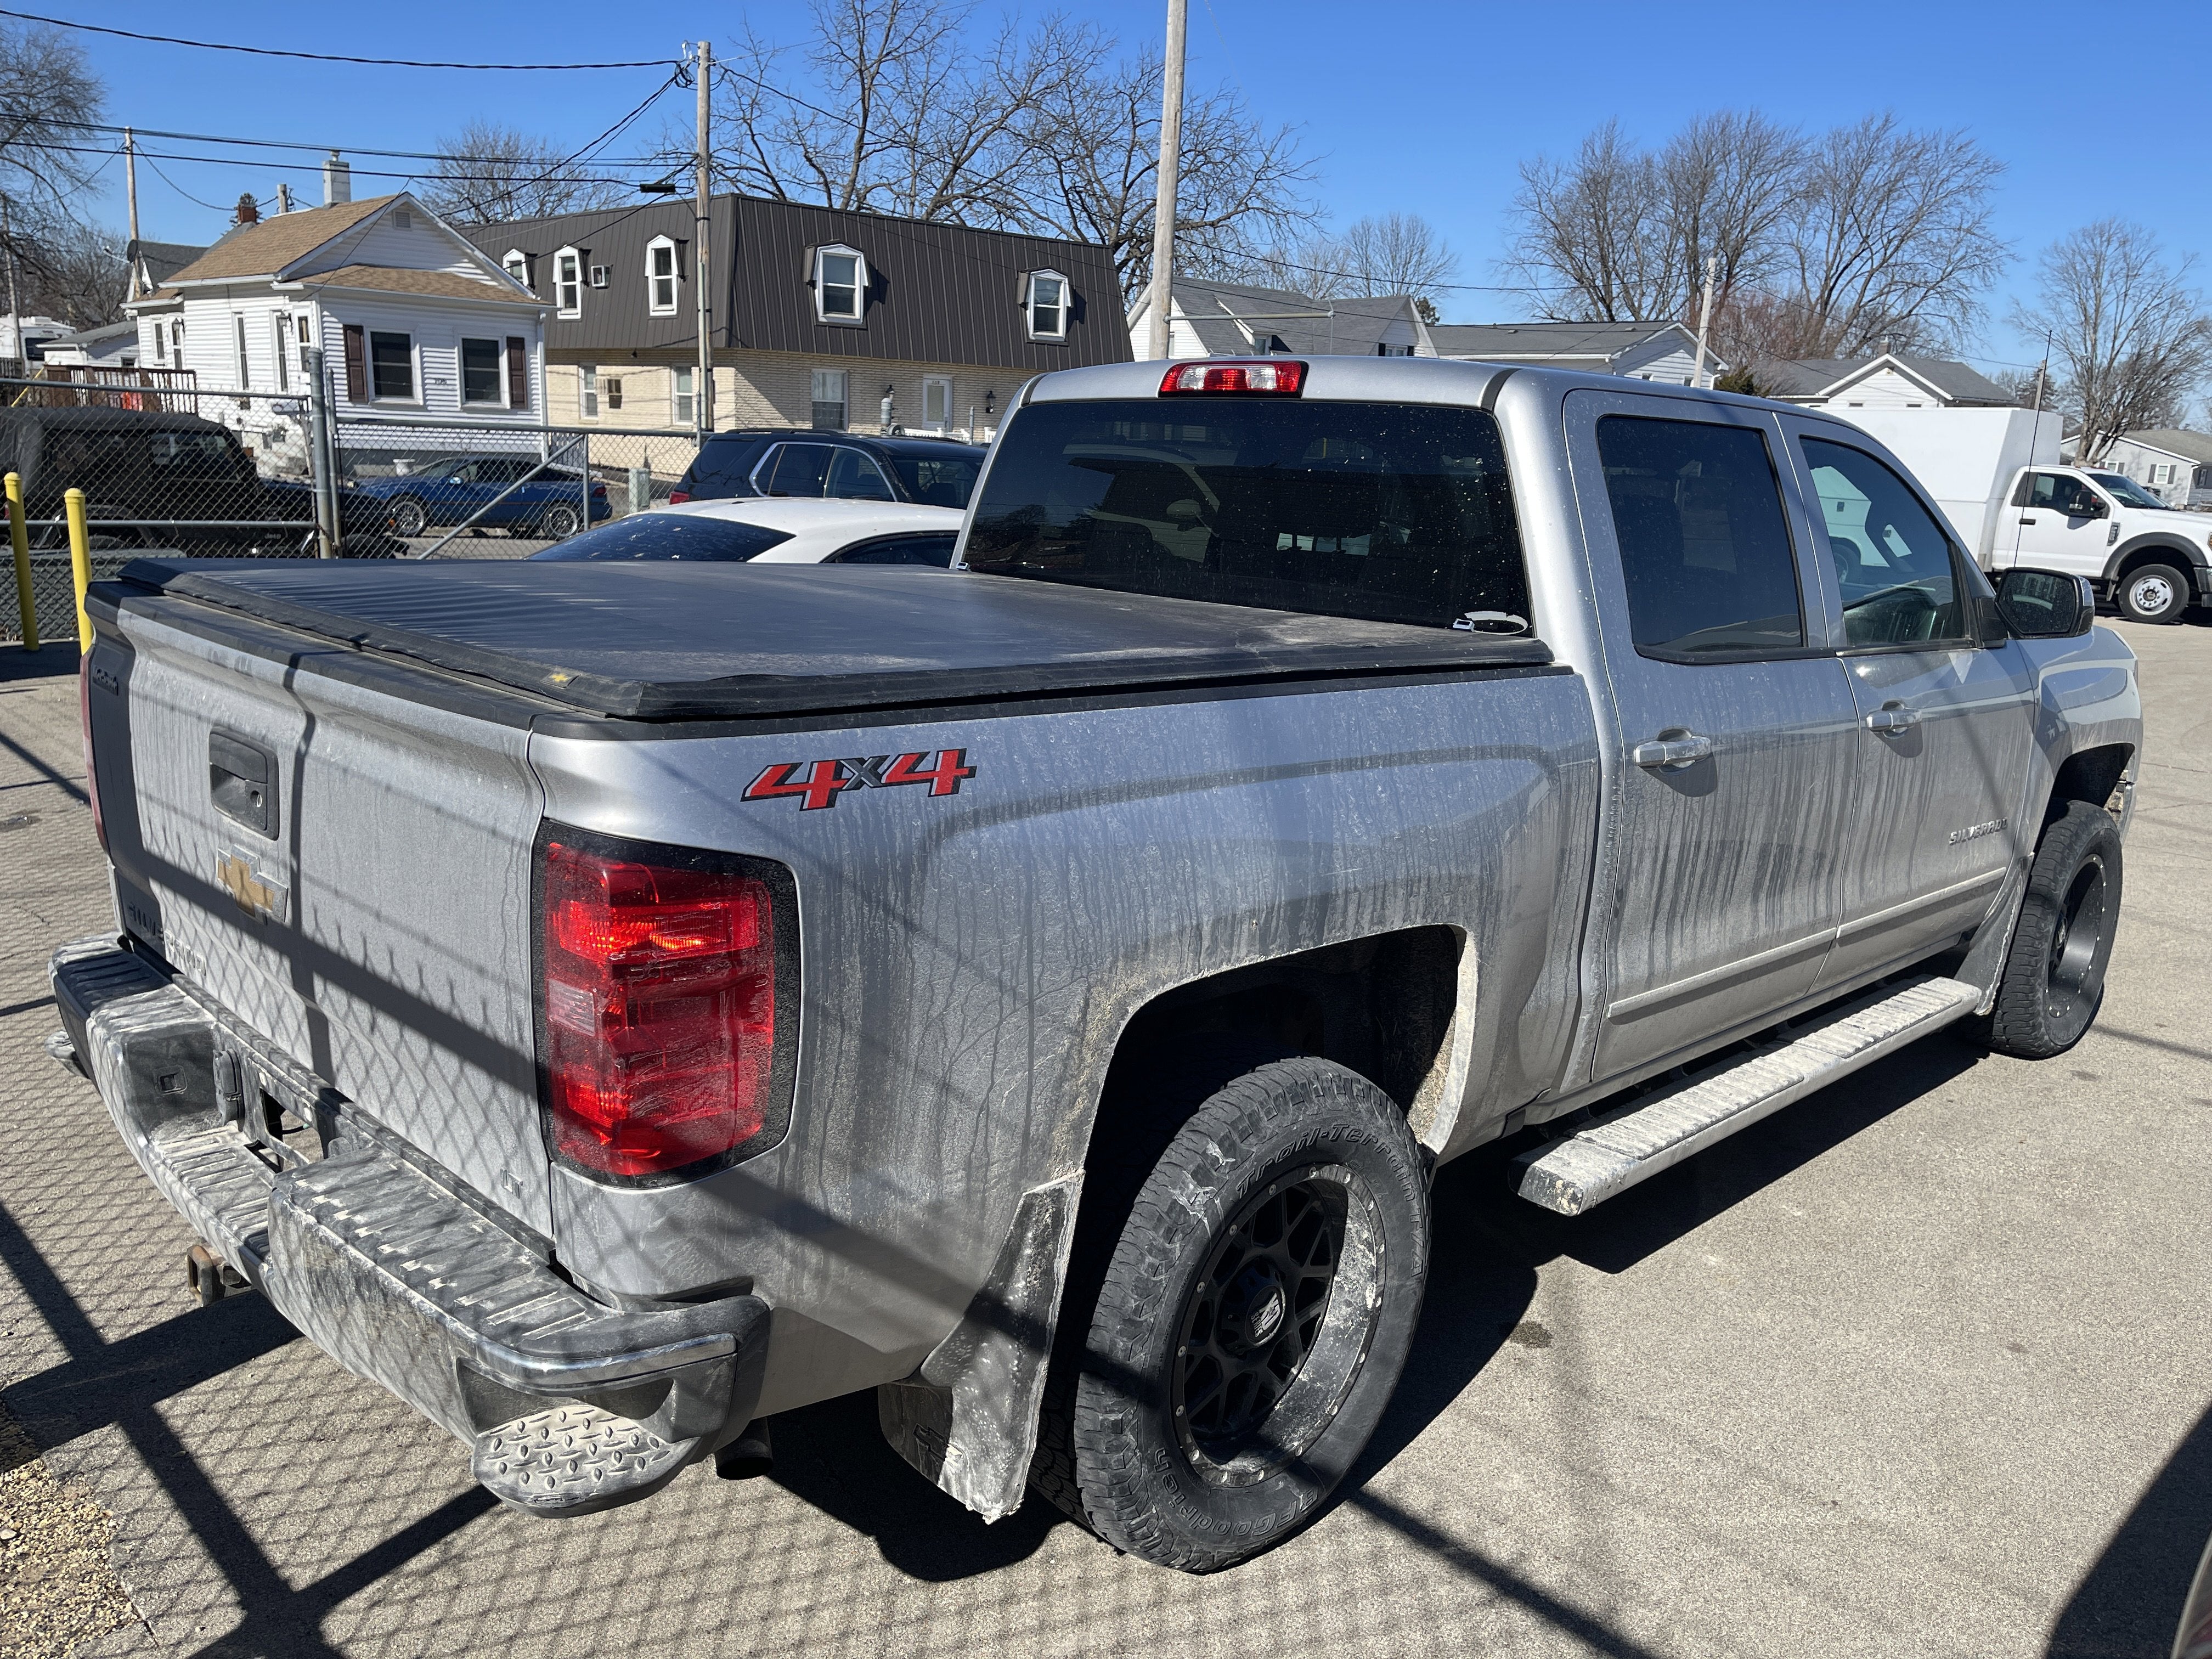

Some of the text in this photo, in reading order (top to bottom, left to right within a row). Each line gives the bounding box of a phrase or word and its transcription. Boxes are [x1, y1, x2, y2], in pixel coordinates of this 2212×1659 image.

[1949, 817, 2008, 845] SILVERADO
[500, 1167, 523, 1200] LT
[1237, 1124, 1424, 1277] Trail-Terrain T/A
[1154, 1447, 1318, 1536] BFGoodrich
